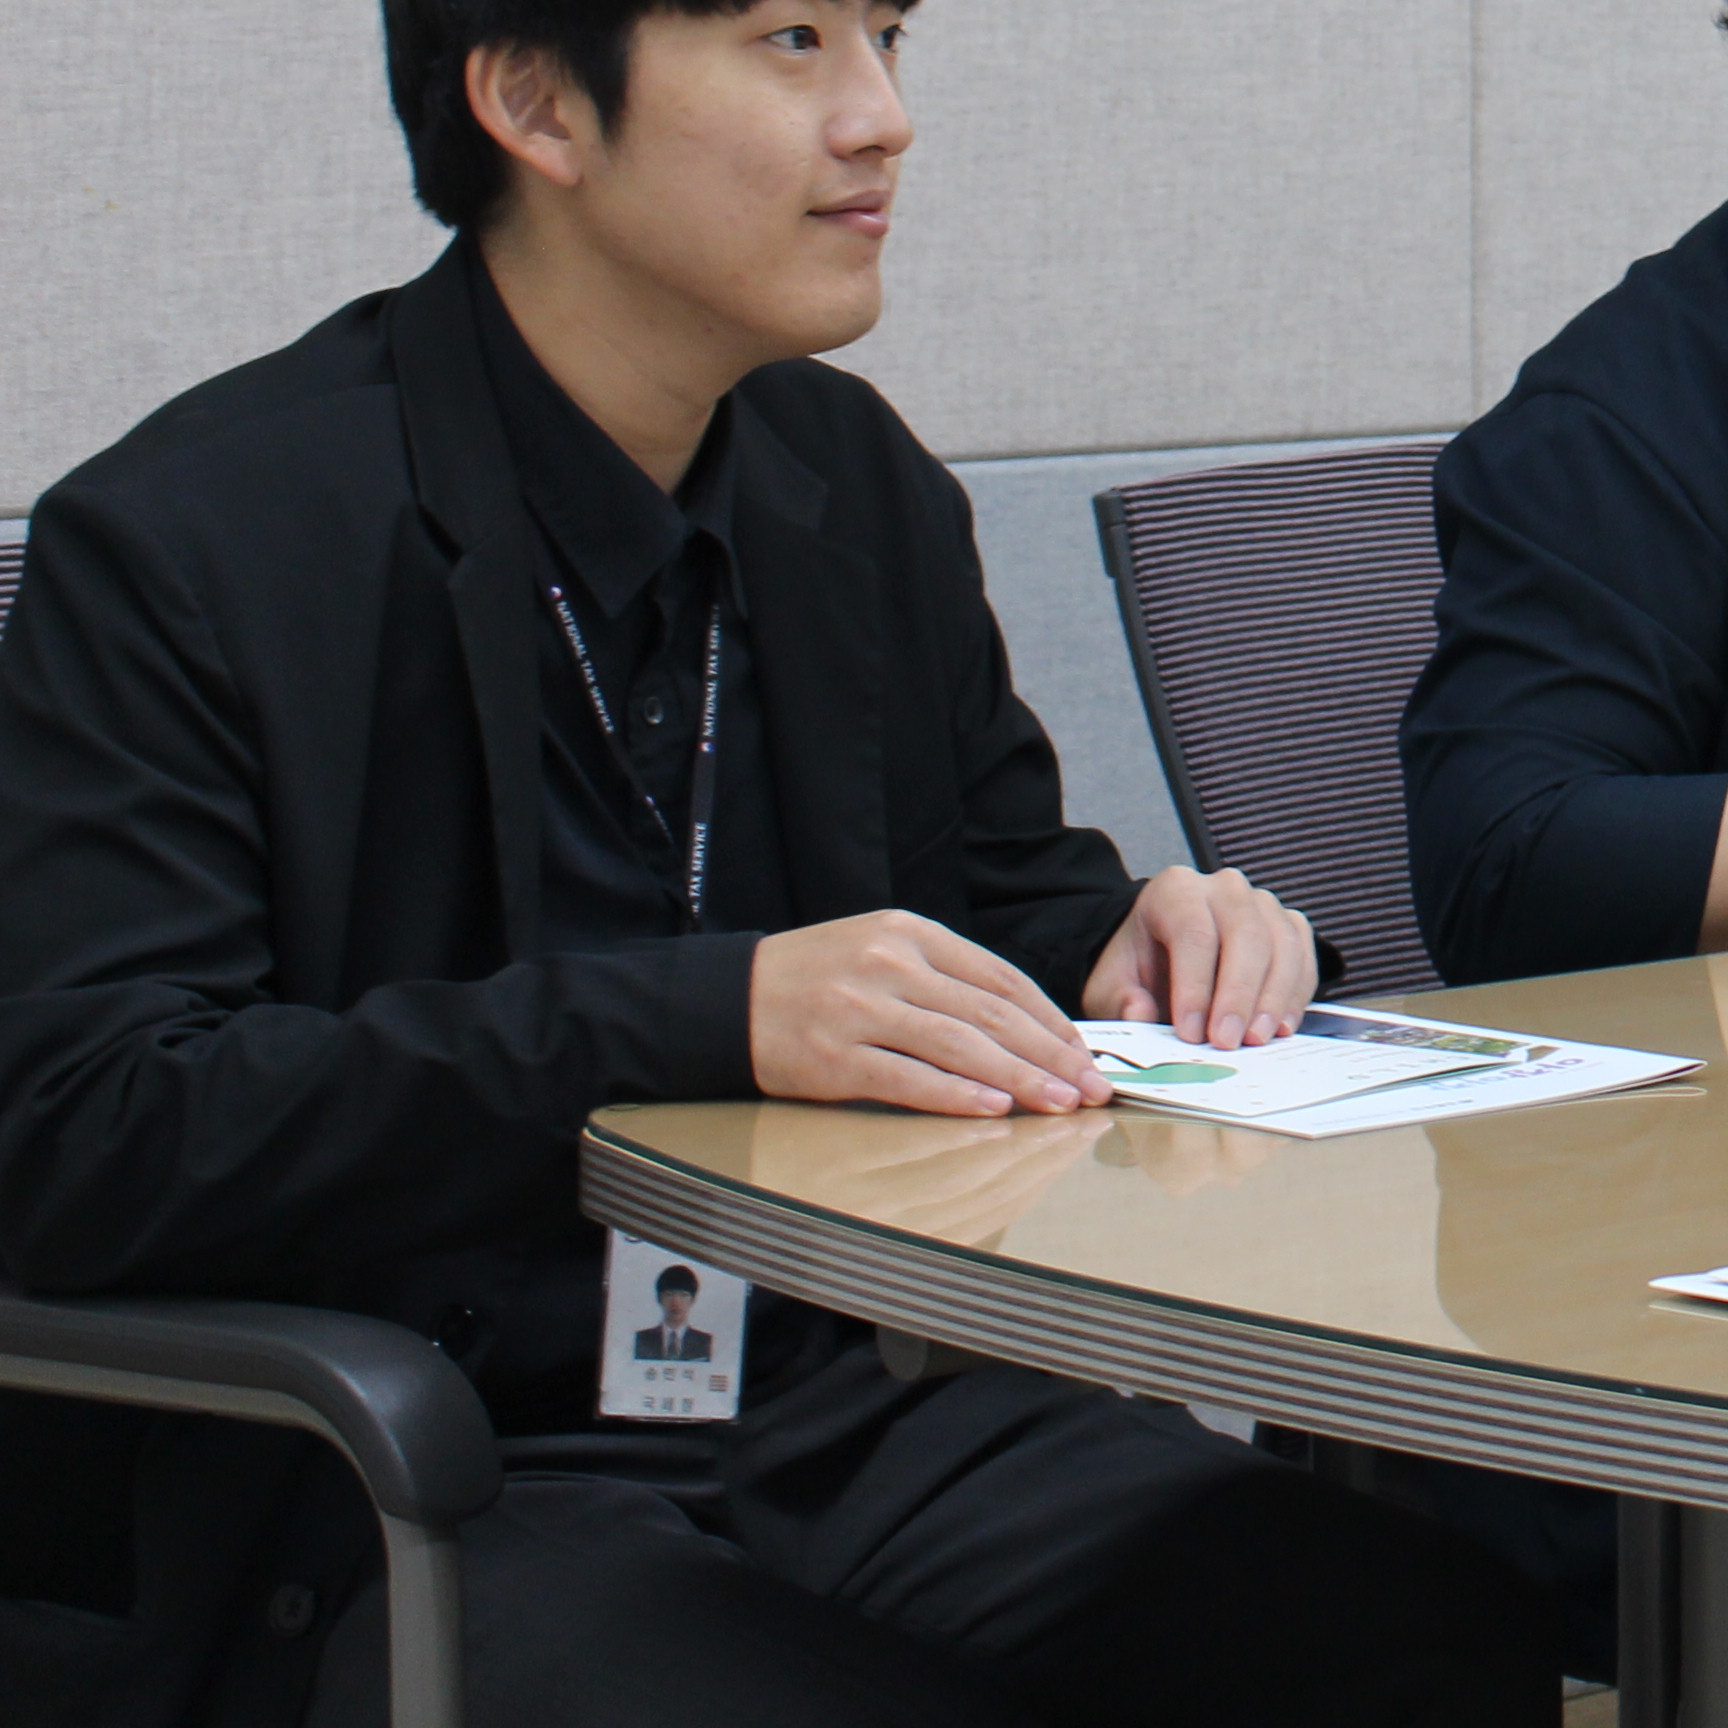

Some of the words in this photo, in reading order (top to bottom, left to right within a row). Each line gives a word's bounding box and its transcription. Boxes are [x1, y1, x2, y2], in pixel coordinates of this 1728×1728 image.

[557, 600, 587, 660] NATIONAL
[580, 659, 597, 684] TAX
[706, 654, 719, 676] TAX
[702, 680, 717, 737] NATIONAL
[690, 821, 708, 872] SERVICE
[687, 874, 703, 898] TAX
